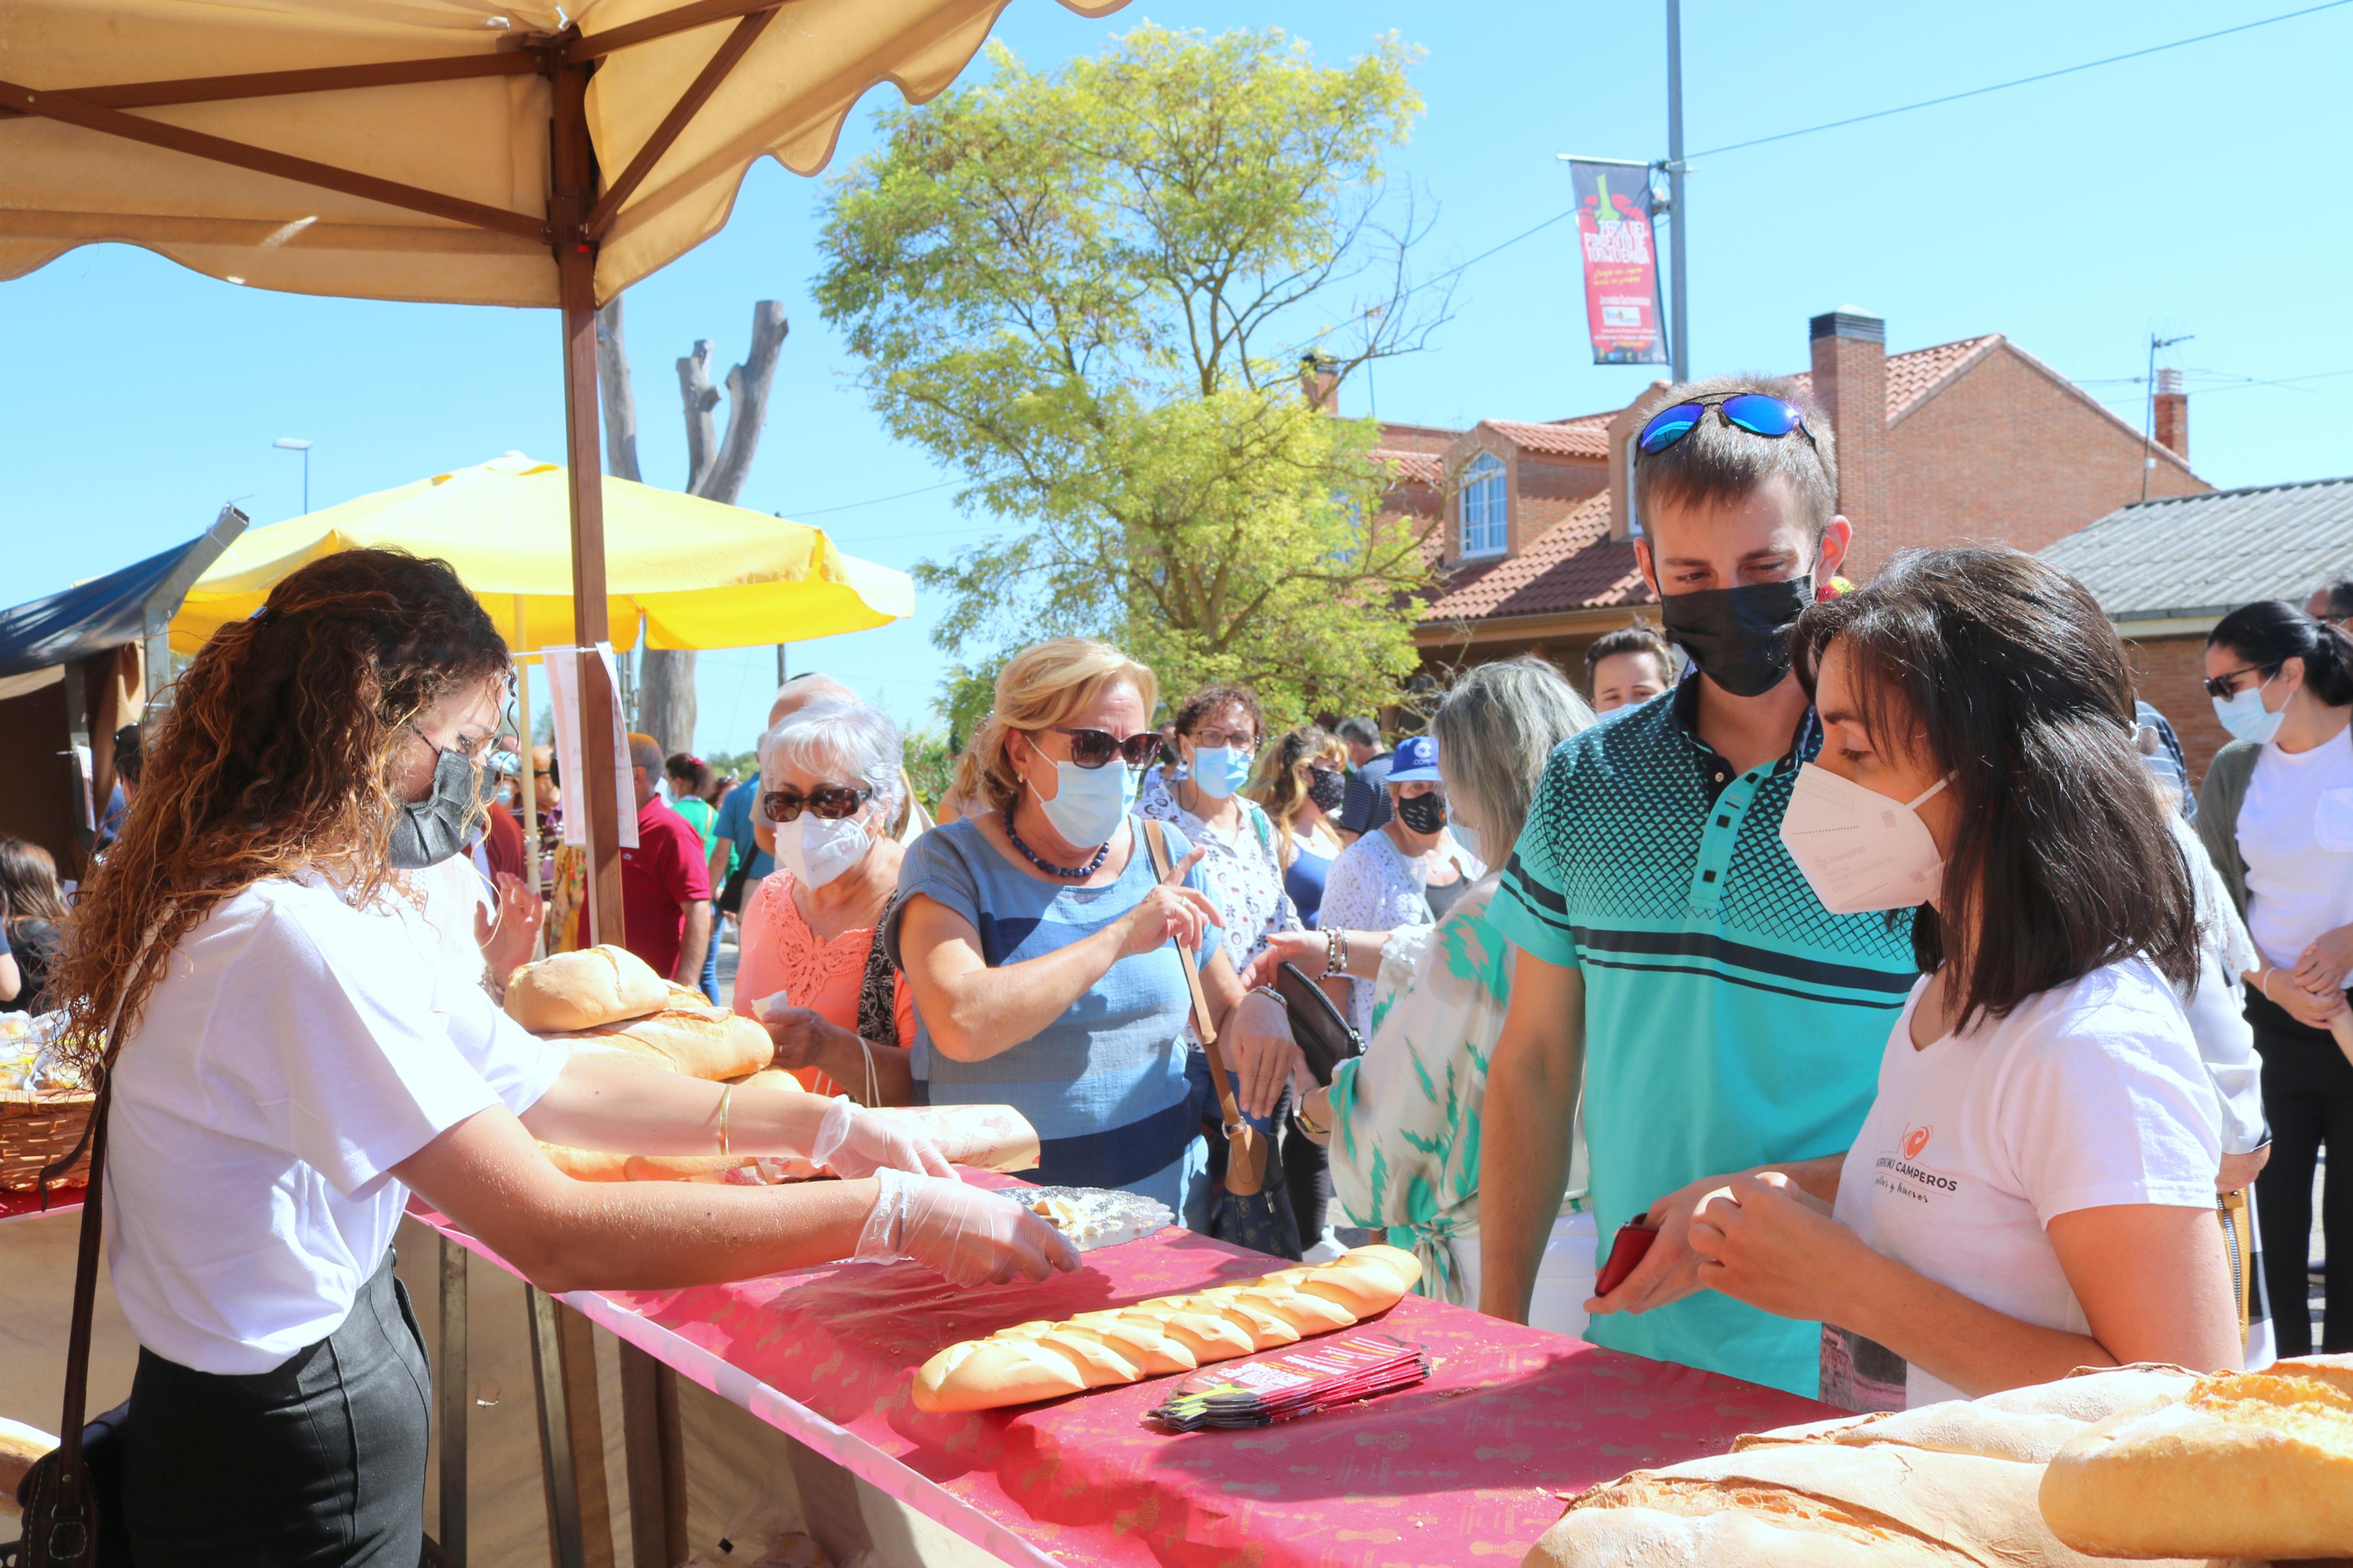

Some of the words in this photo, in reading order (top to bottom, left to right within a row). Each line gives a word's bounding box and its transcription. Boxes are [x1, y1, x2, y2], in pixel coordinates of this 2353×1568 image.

[1896, 1162, 1957, 1191] CAMPEROS
[1889, 1183, 1894, 1194] y
[1897, 1182, 1928, 1203] huevos
